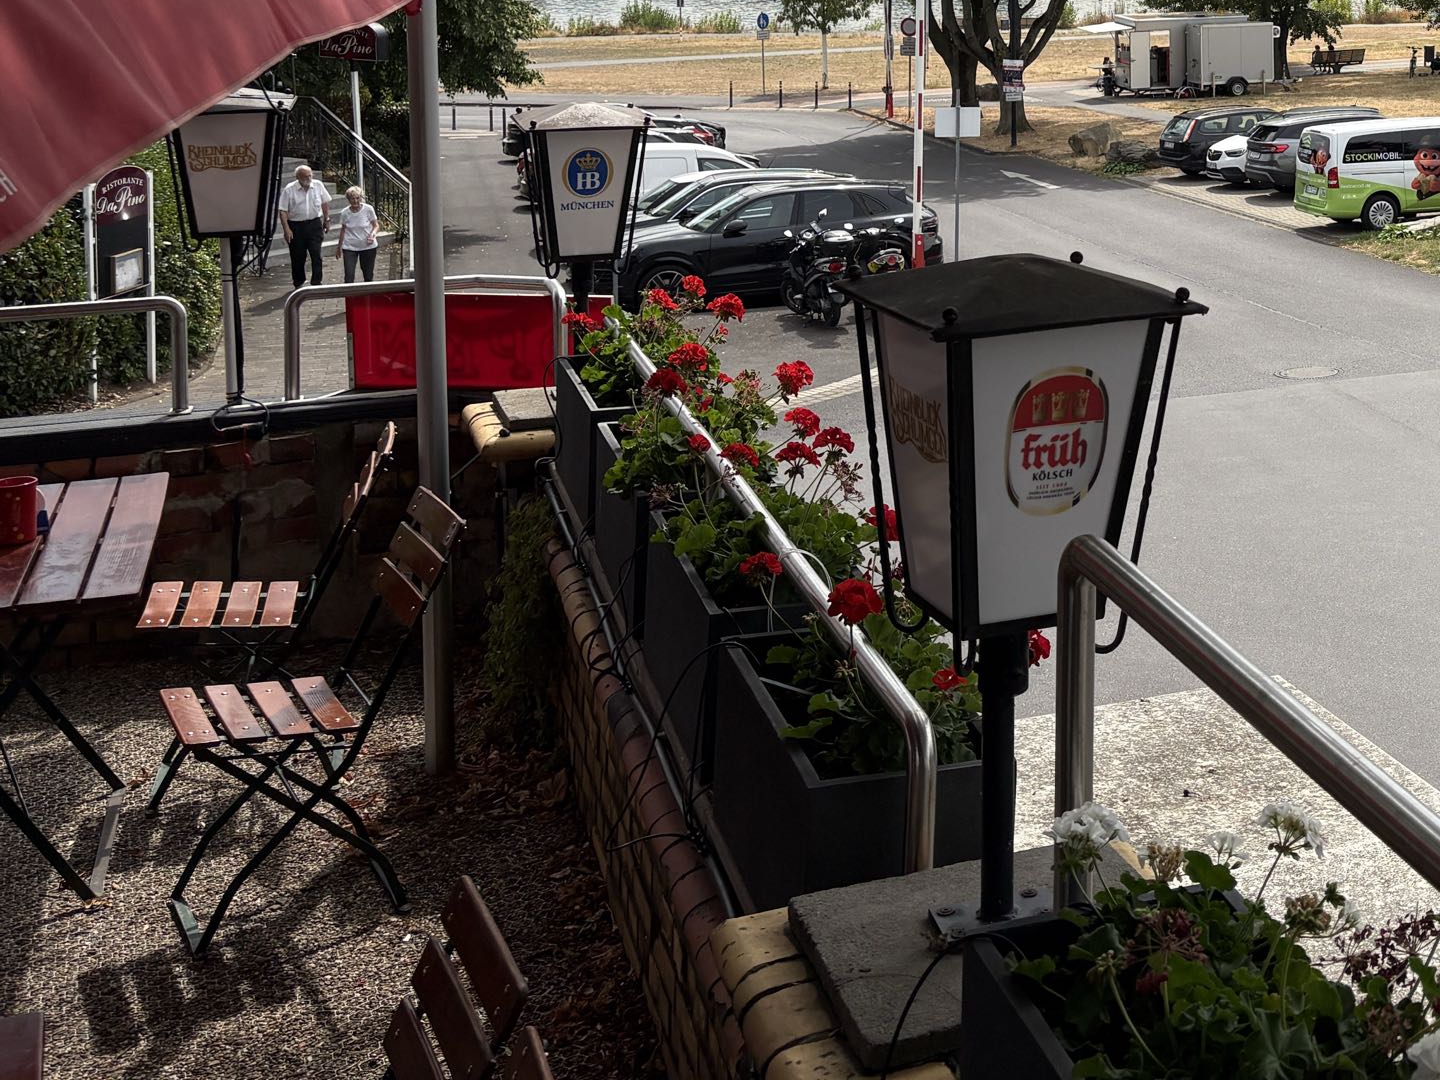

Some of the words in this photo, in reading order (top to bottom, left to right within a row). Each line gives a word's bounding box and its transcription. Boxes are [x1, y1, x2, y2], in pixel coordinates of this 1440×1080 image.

[338, 34, 373, 55] Pino
[1345, 152, 1402, 162] STOCKIMOBIL
[101, 177, 144, 195] RISTORANTE
[576, 171, 601, 190] HB
[96, 196, 116, 214] Da
[113, 185, 146, 214] Pino
[560, 200, 615, 212] MÜNCHEN
[1020, 427, 1088, 471] früh
[1032, 468, 1074, 482] KÖLSCH
